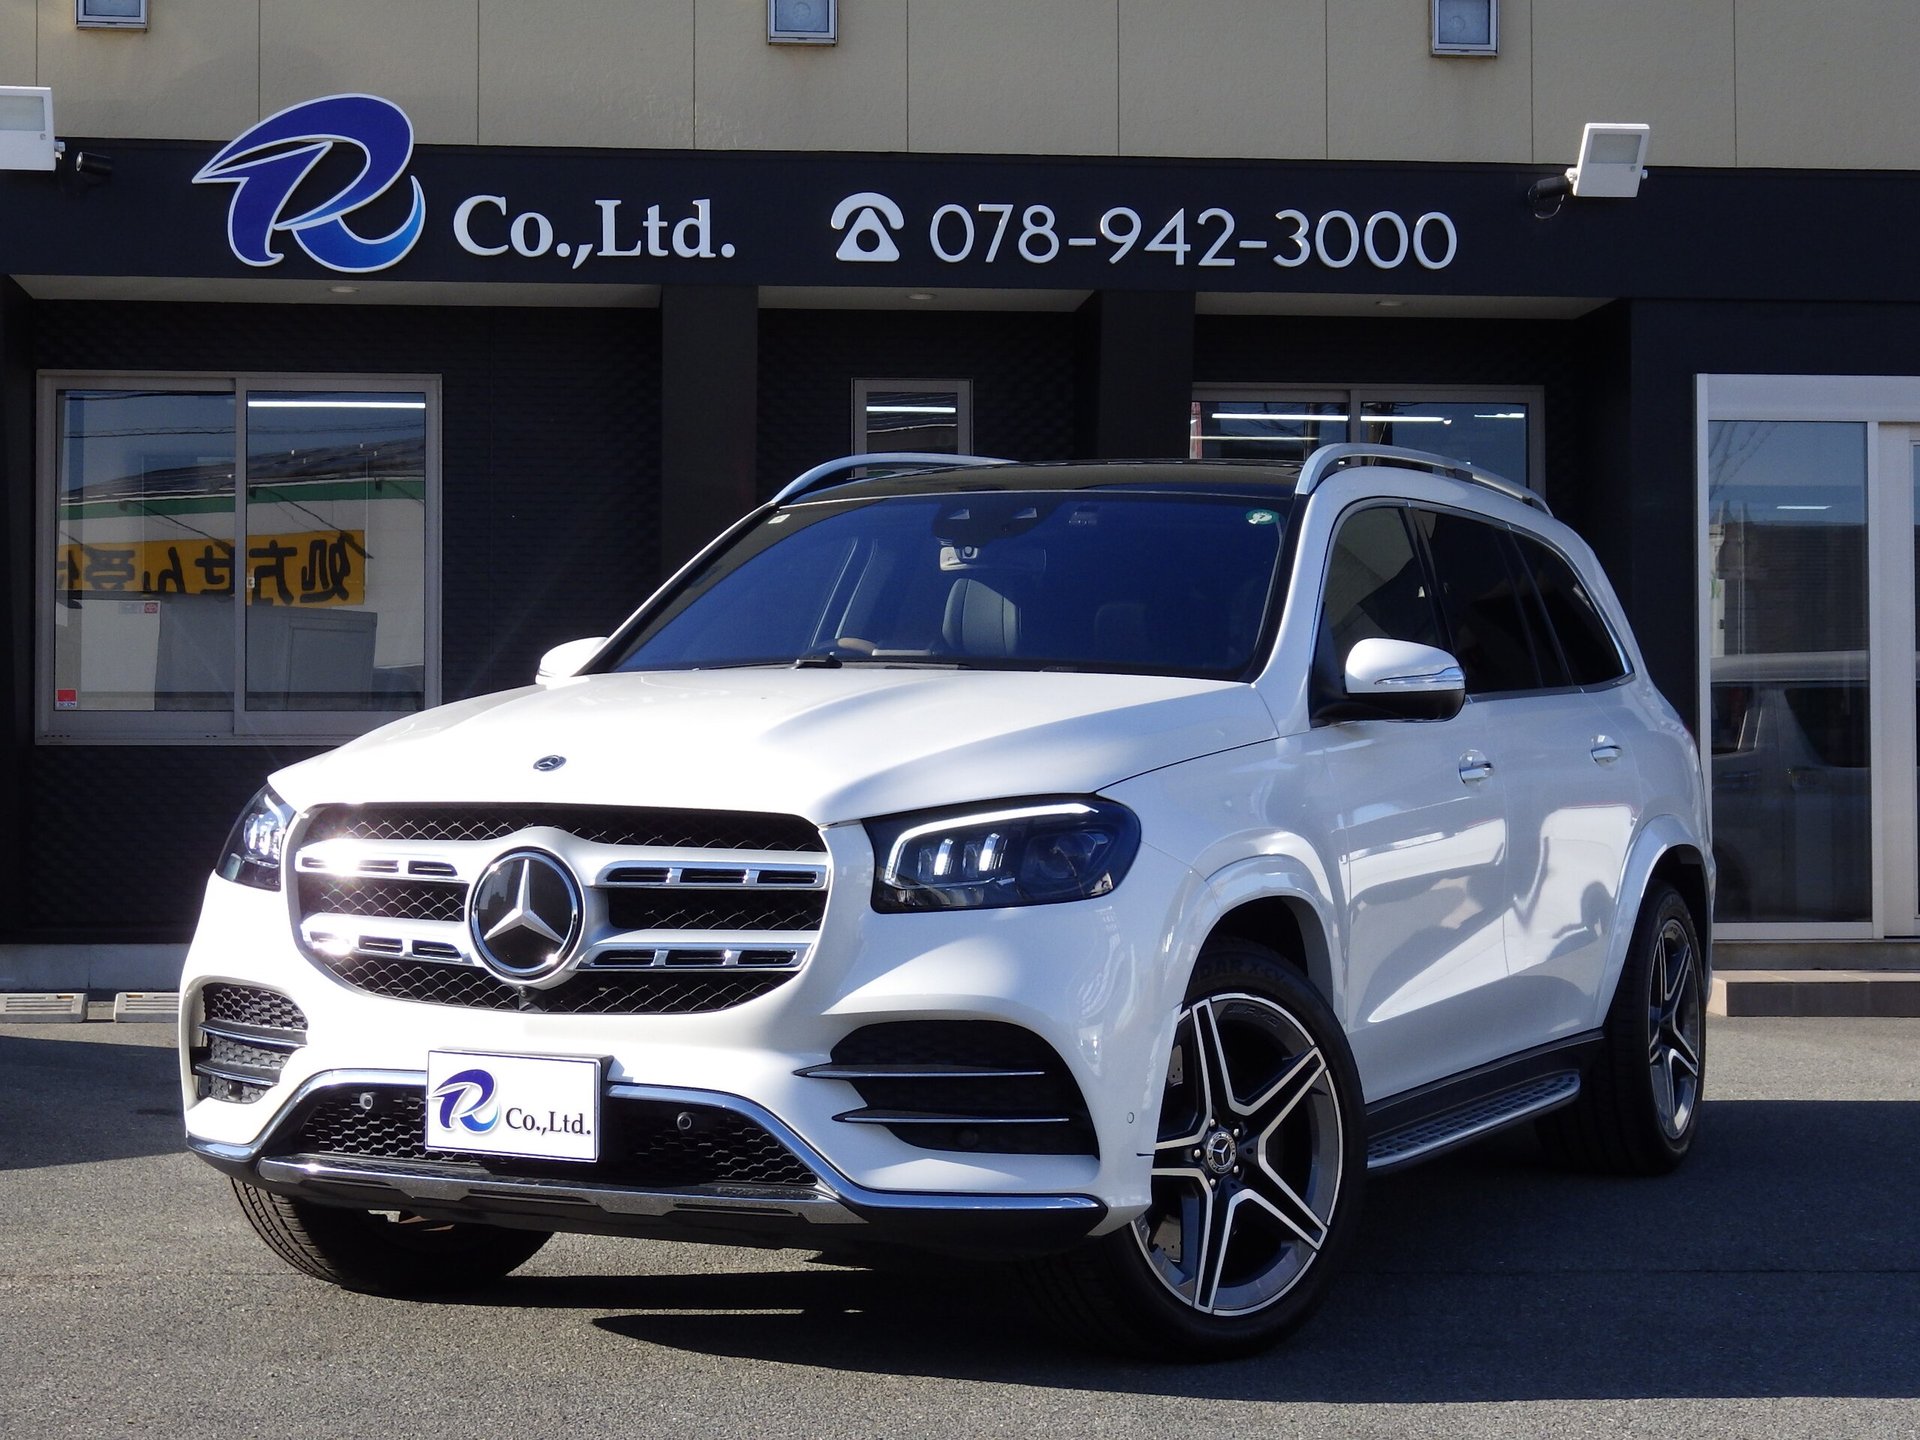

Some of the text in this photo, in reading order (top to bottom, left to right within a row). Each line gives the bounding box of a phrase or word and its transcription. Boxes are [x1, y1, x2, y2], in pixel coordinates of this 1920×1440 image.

[192, 92, 736, 273] R Co.,Ltd.
[930, 203, 1458, 270] 078-942-3000
[431, 1068, 592, 1136] R Co.,Ltd.
